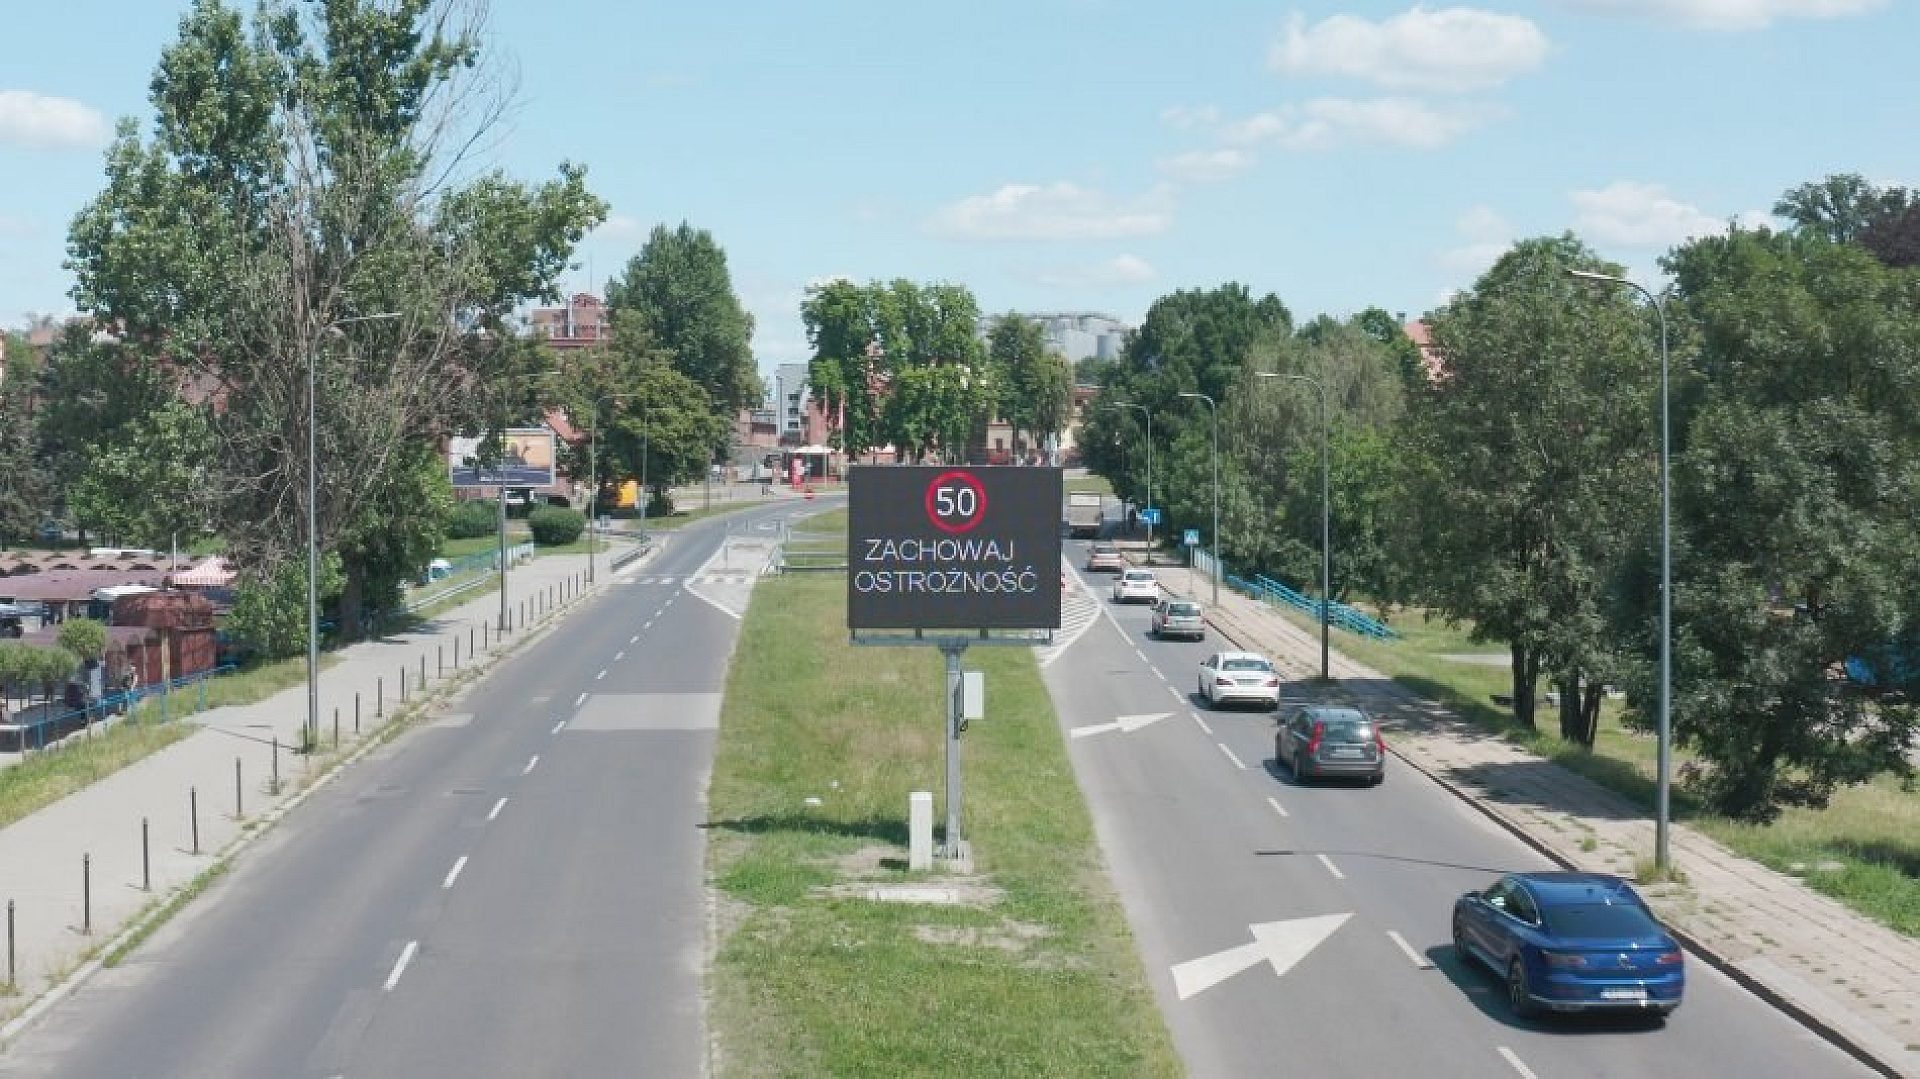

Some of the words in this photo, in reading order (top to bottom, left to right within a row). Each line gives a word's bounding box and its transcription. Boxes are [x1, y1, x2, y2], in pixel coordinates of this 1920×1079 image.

[937, 487, 976, 516] 50
[864, 538, 1014, 561] ZACHOWAJ
[854, 565, 1037, 593] OSTROŻNOŚĆ
